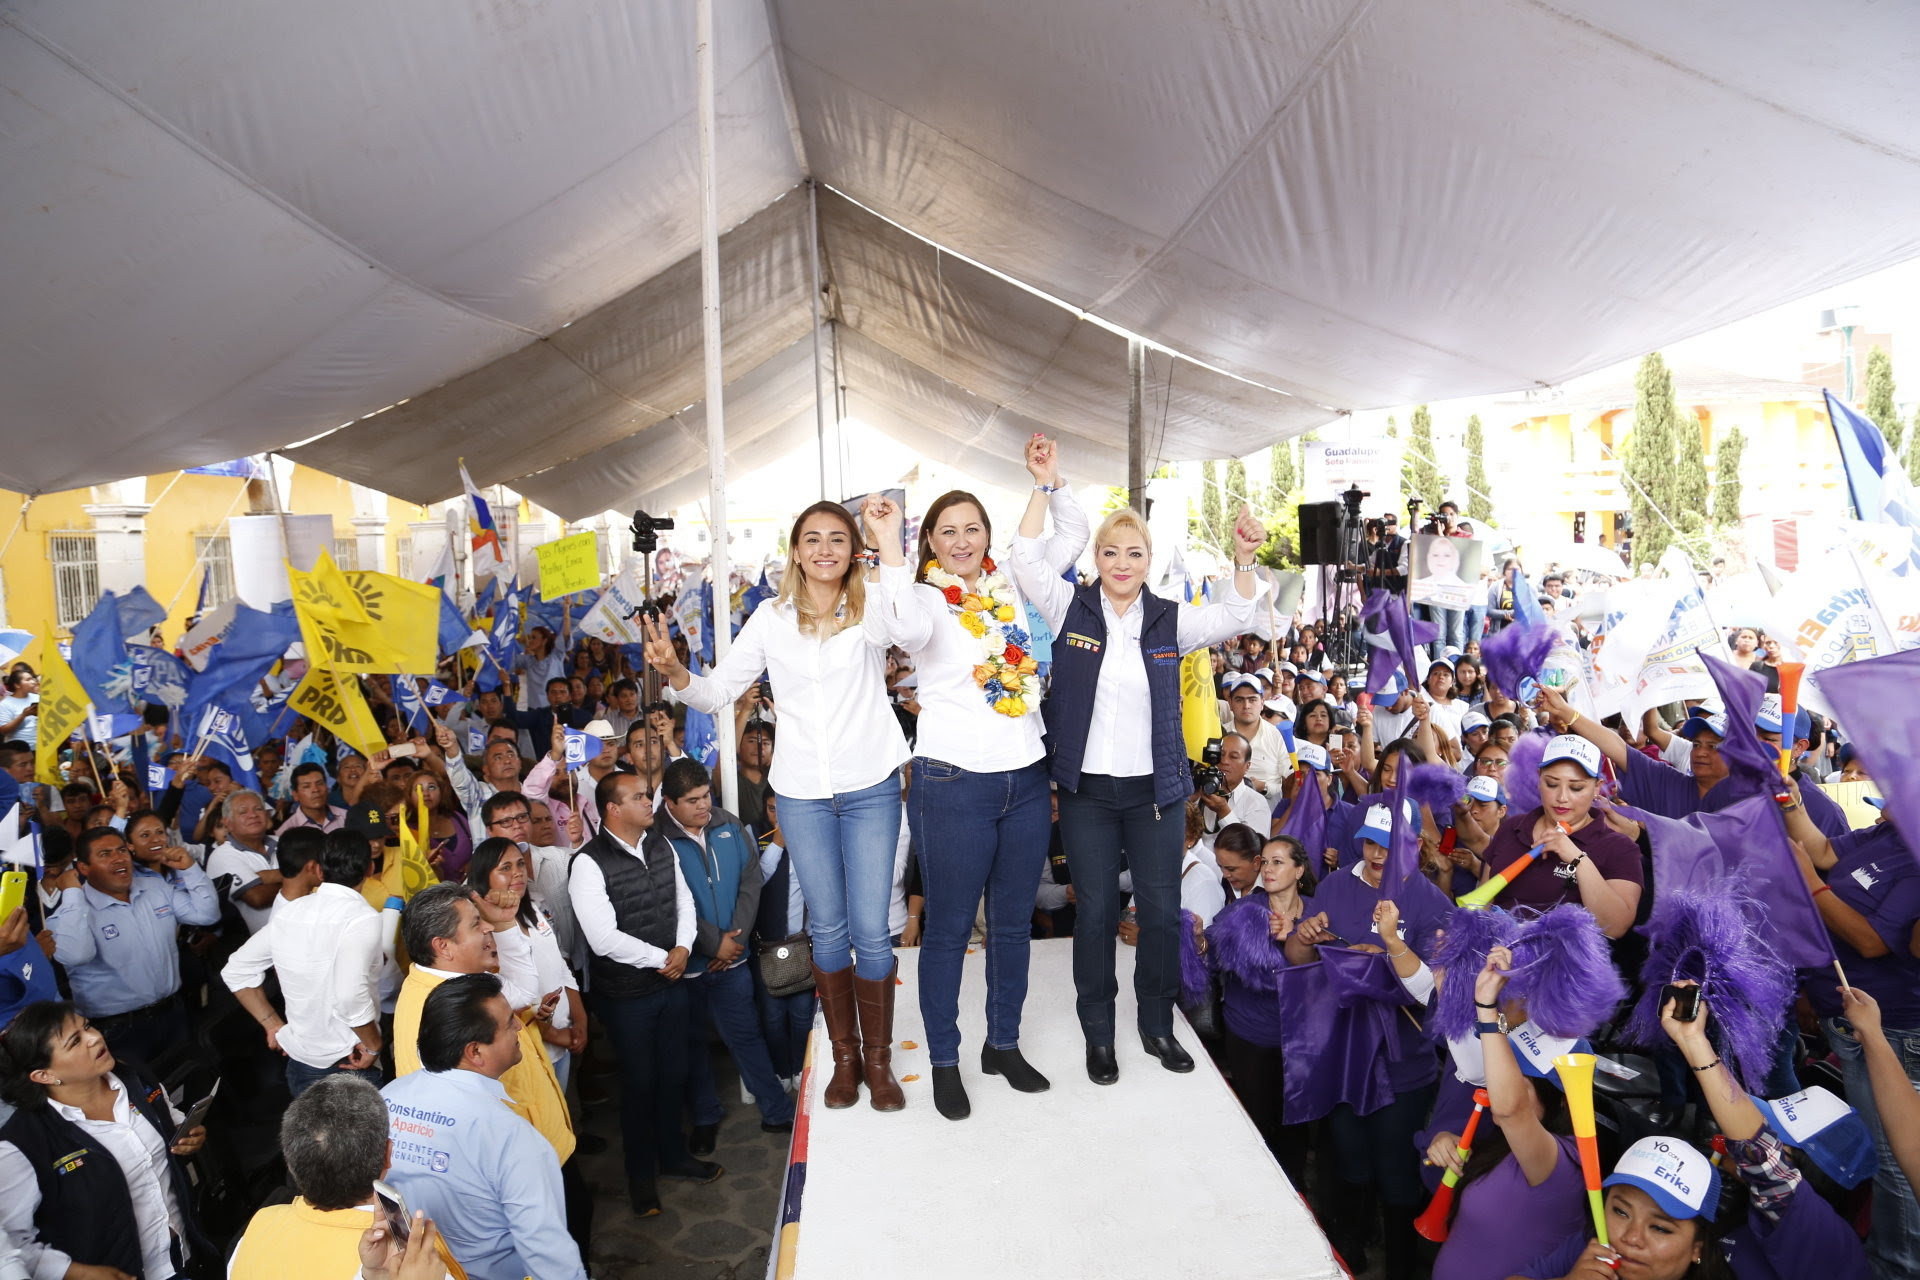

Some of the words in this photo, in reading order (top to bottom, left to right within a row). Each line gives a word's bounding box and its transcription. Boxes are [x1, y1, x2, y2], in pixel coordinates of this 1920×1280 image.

[1324, 446, 1380, 457] Guadalupe
[1325, 458, 1345, 466] Soto
[296, 685, 348, 725] PRD
[1759, 707, 1781, 720] Erika
[1570, 748, 1592, 763] Erika
[1380, 817, 1392, 827] Eri
[1518, 1030, 1542, 1057] Erika
[1778, 1097, 1798, 1122] Erika
[391, 1117, 435, 1138] Aparicio
[391, 1139, 433, 1156] SIDENTE
[1653, 1141, 1670, 1153] YO
[1653, 1165, 1691, 1196] Erika
